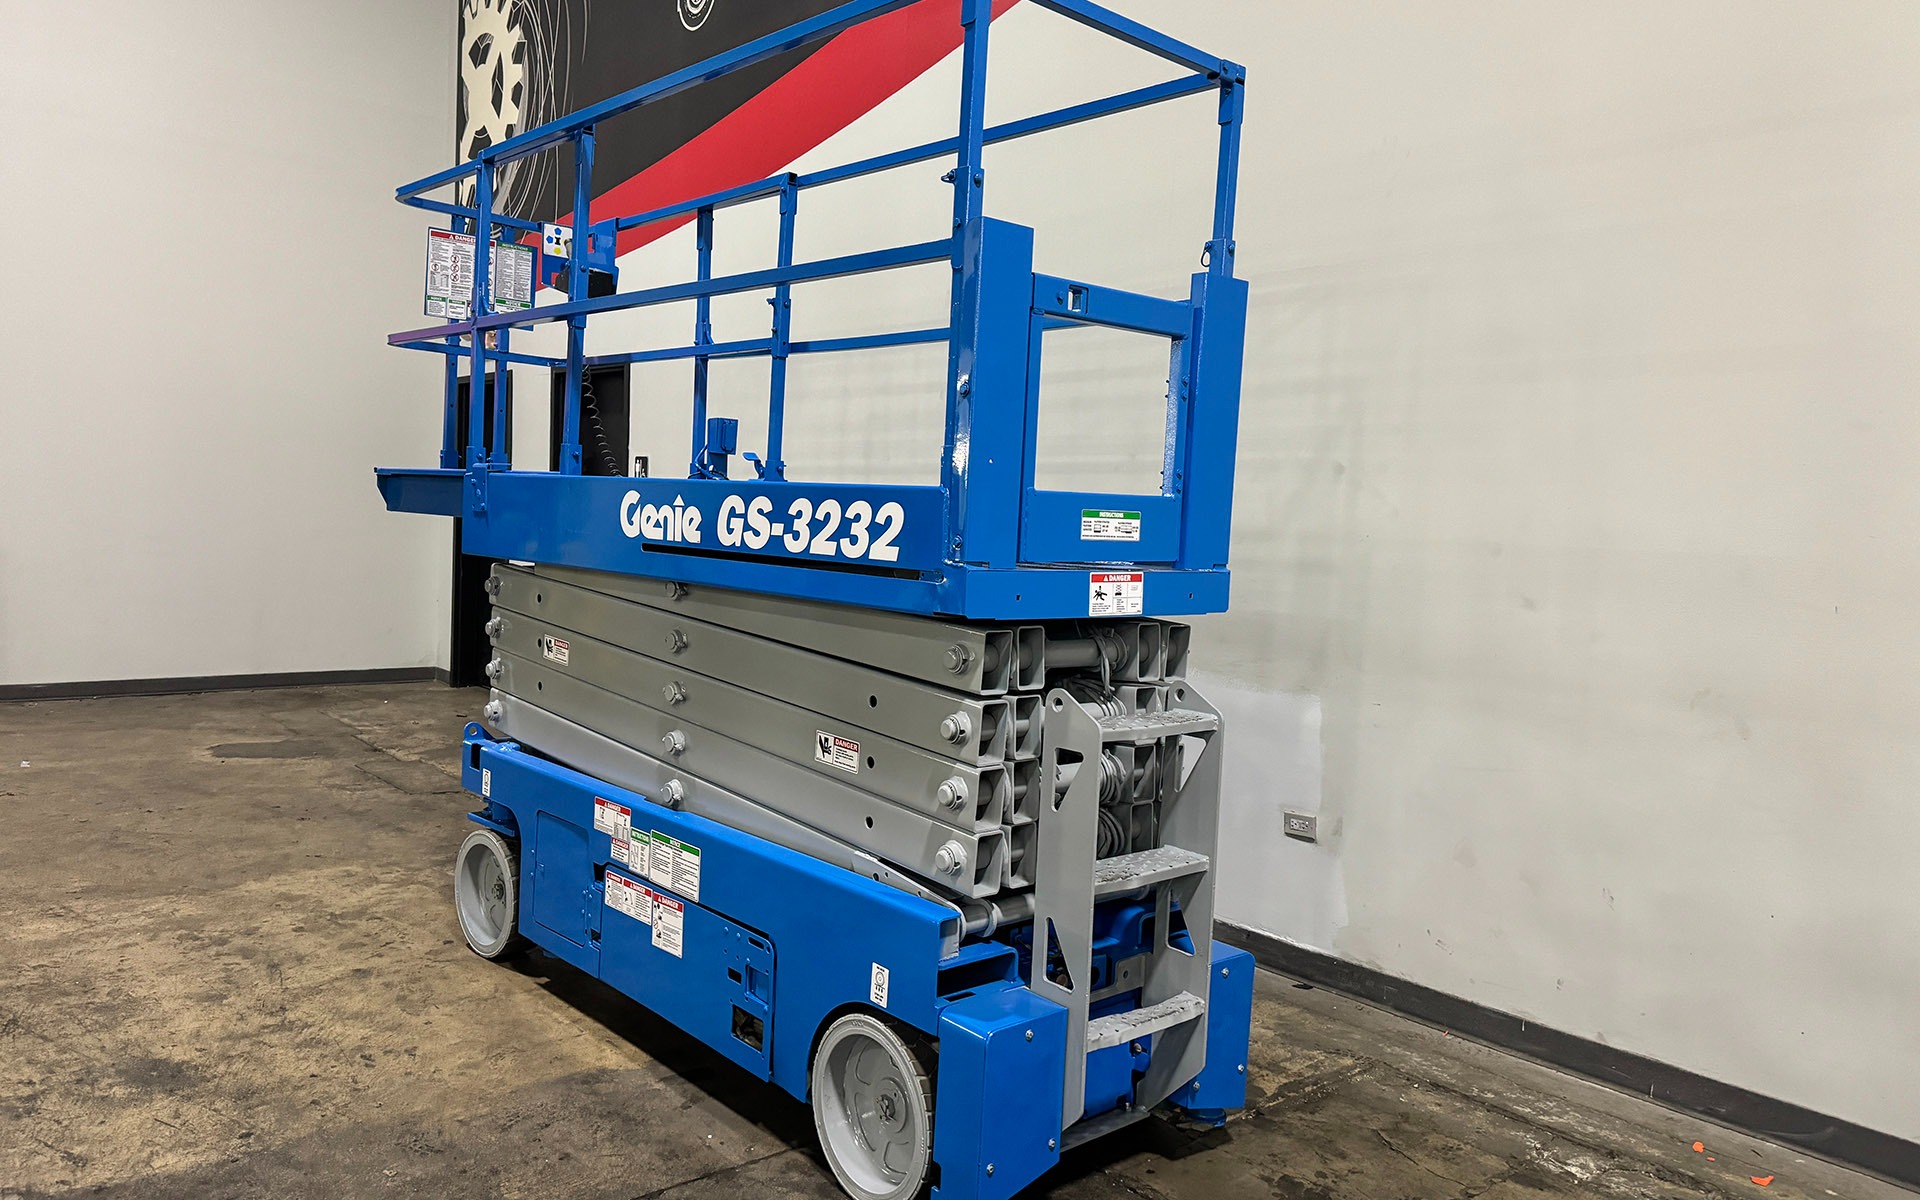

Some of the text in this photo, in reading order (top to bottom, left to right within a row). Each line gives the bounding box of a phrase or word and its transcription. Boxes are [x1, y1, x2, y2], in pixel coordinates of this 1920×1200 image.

[621, 490, 905, 562] Genie GS-3232
[555, 640, 568, 649] DANGER
[835, 738, 858, 751] DANGER
[607, 802, 622, 812] DANGER
[615, 838, 629, 849] DANGER
[609, 874, 621, 883] DANGER
[633, 884, 646, 894] DANGER
[661, 898, 679, 909] DANGER
